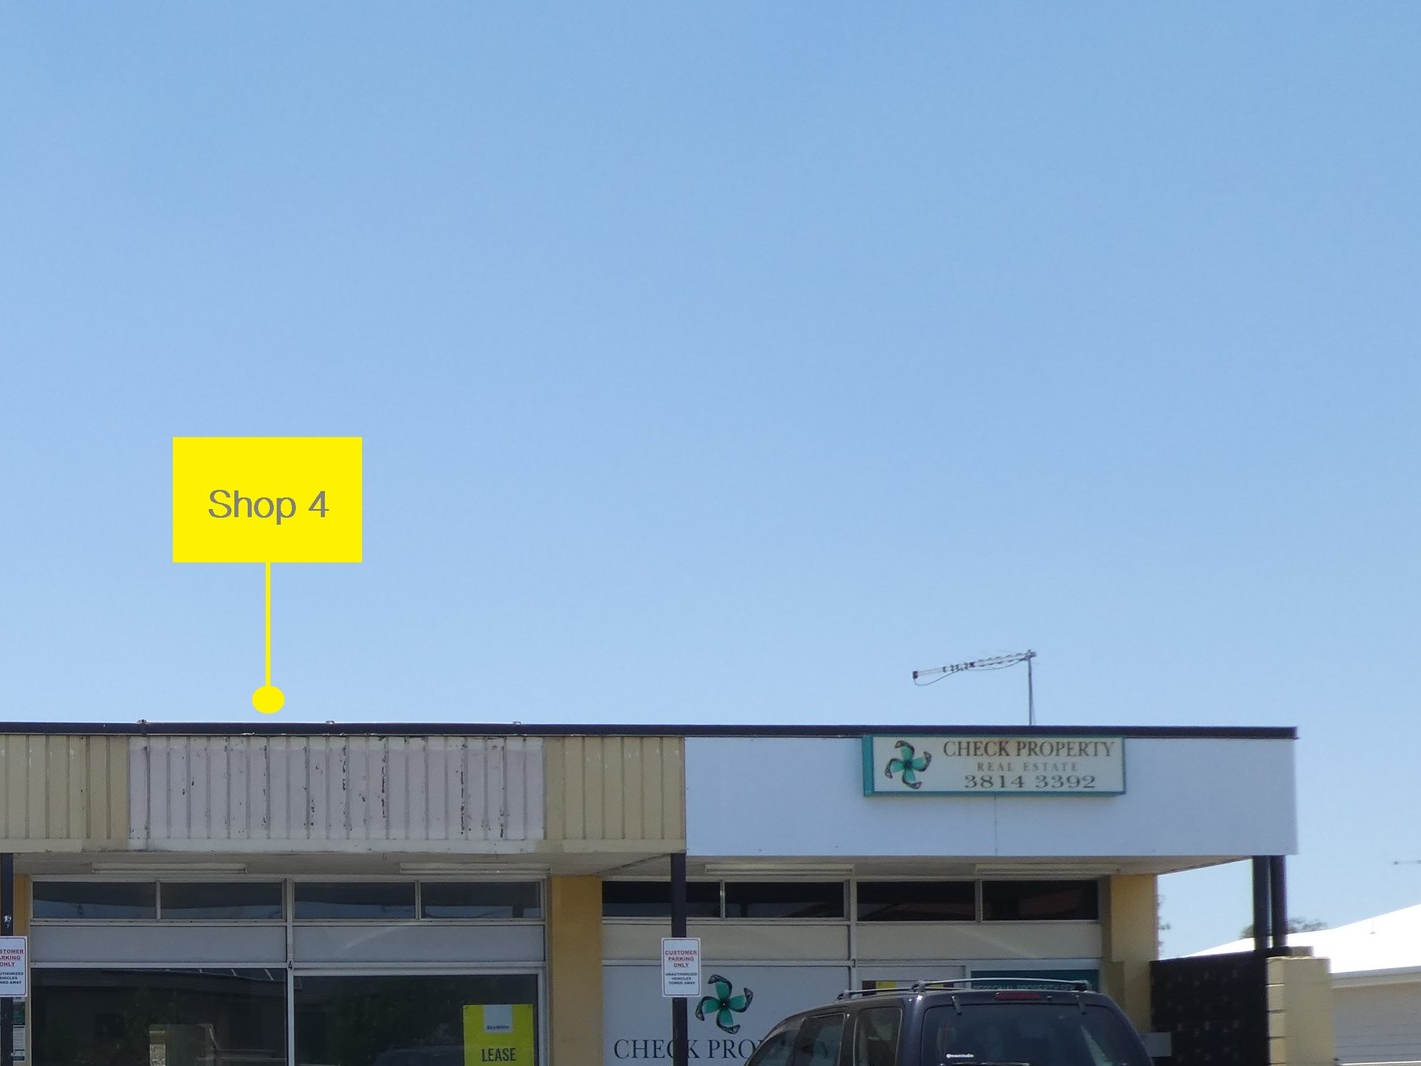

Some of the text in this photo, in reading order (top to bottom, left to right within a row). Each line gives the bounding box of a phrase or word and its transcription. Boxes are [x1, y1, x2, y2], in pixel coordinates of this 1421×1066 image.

[943, 740, 1115, 757] CHECK PROPERTY
[977, 761, 1079, 772] REAL ESTATE
[964, 774, 1096, 789] 3814 3392
[288, 961, 293, 970] 4
[481, 1047, 516, 1063] LEASE
